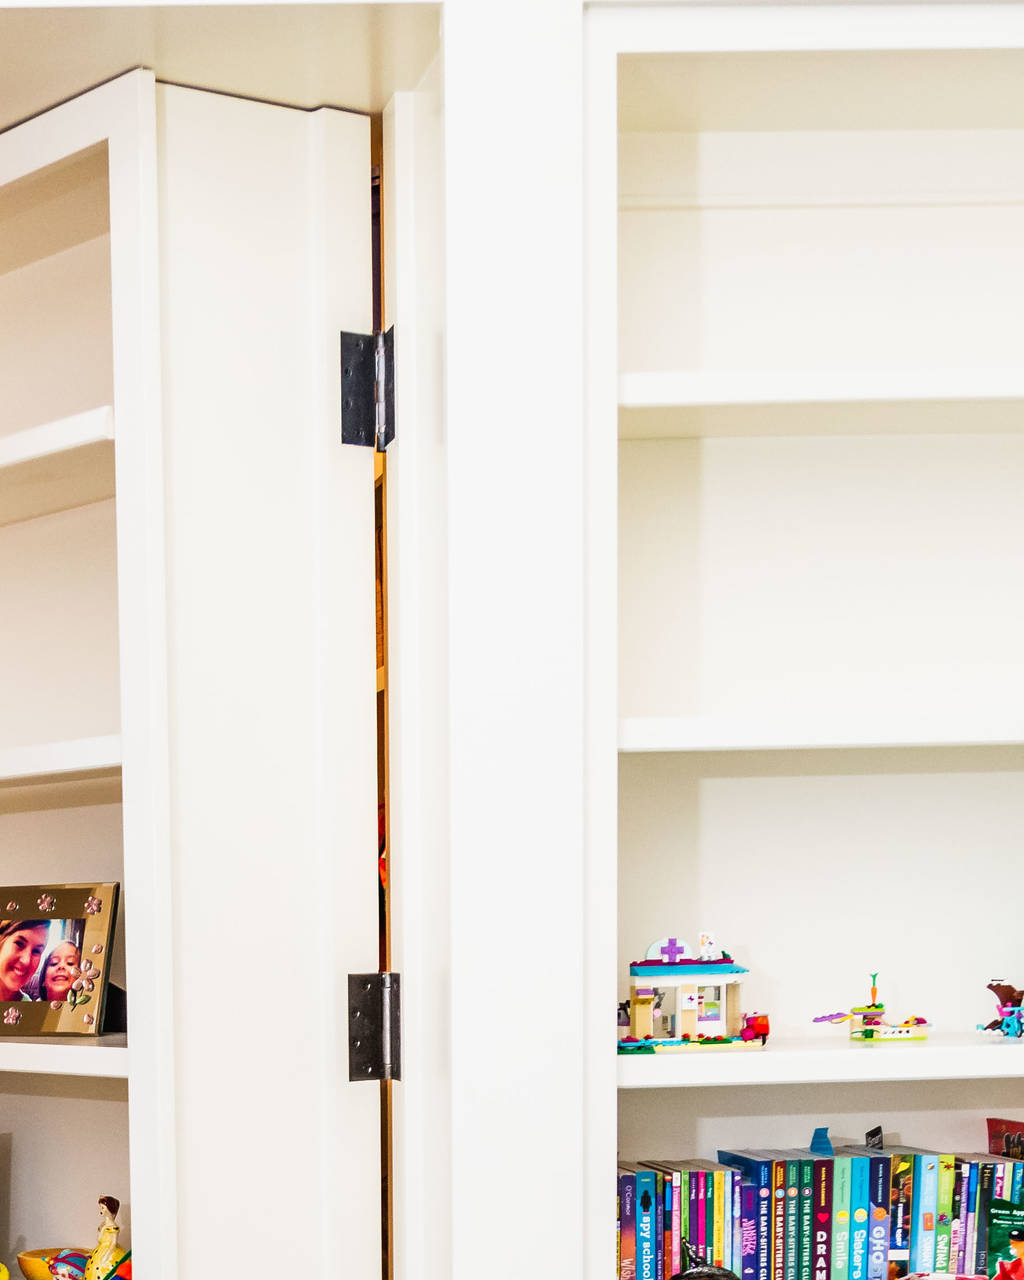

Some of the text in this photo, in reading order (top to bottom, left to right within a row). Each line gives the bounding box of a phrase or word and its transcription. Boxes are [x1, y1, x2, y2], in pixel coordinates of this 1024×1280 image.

[641, 1216, 650, 1237] spy
[835, 1231, 848, 1268] Smile
[852, 1229, 865, 1279] Sisters
[936, 1234, 947, 1265] SWING
[621, 1257, 633, 1280] Wish
